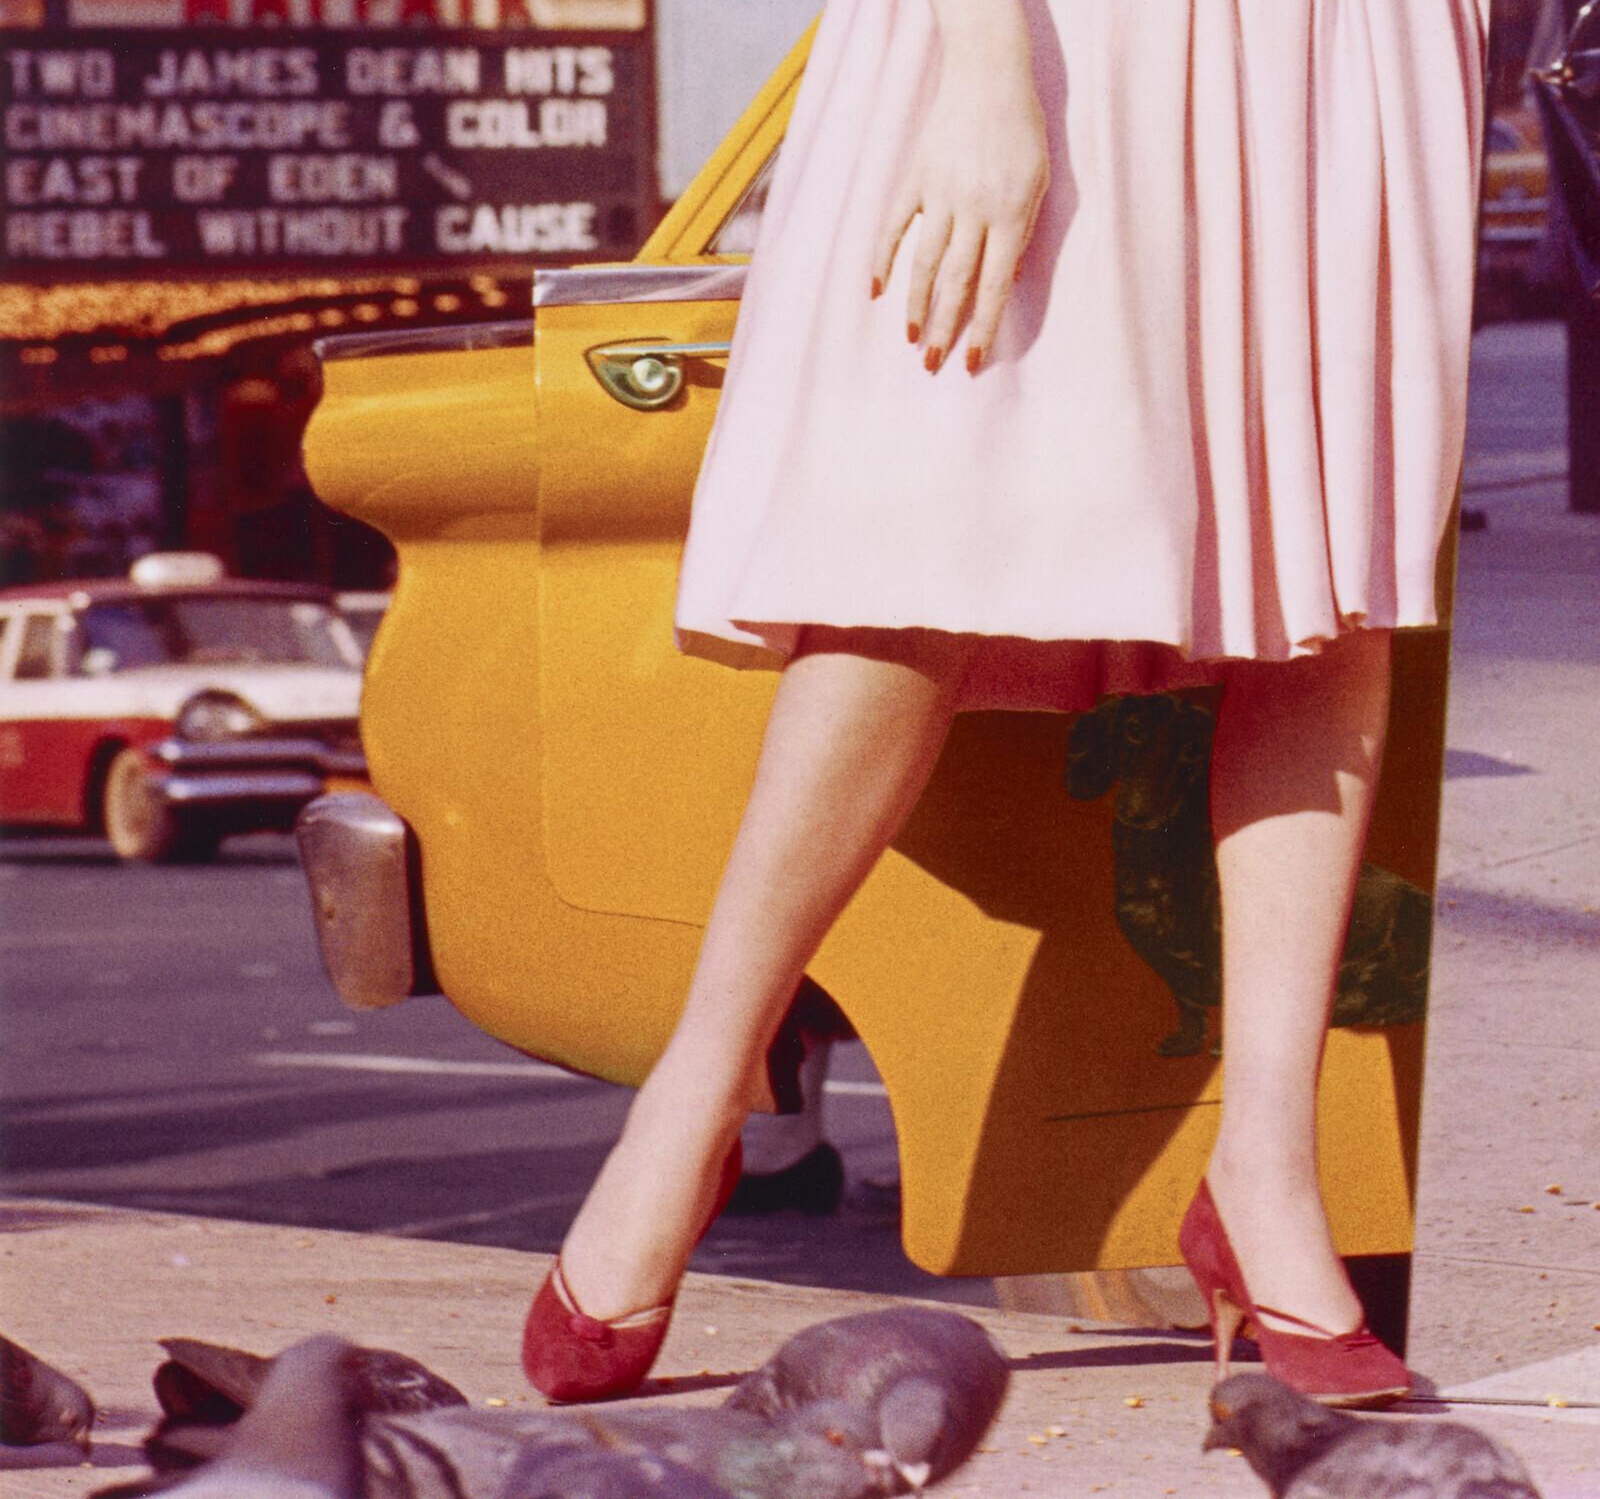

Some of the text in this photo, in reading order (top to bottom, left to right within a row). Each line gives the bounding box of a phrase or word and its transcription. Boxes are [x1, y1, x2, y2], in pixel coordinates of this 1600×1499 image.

[9, 47, 614, 96] TWO JAMES DEAN HITS
[3, 99, 607, 150] CINEMASCOPE & COLOR
[4, 155, 398, 204] EAST OF EDEN
[4, 203, 598, 259] REBEL WITHOUT CAUSE
